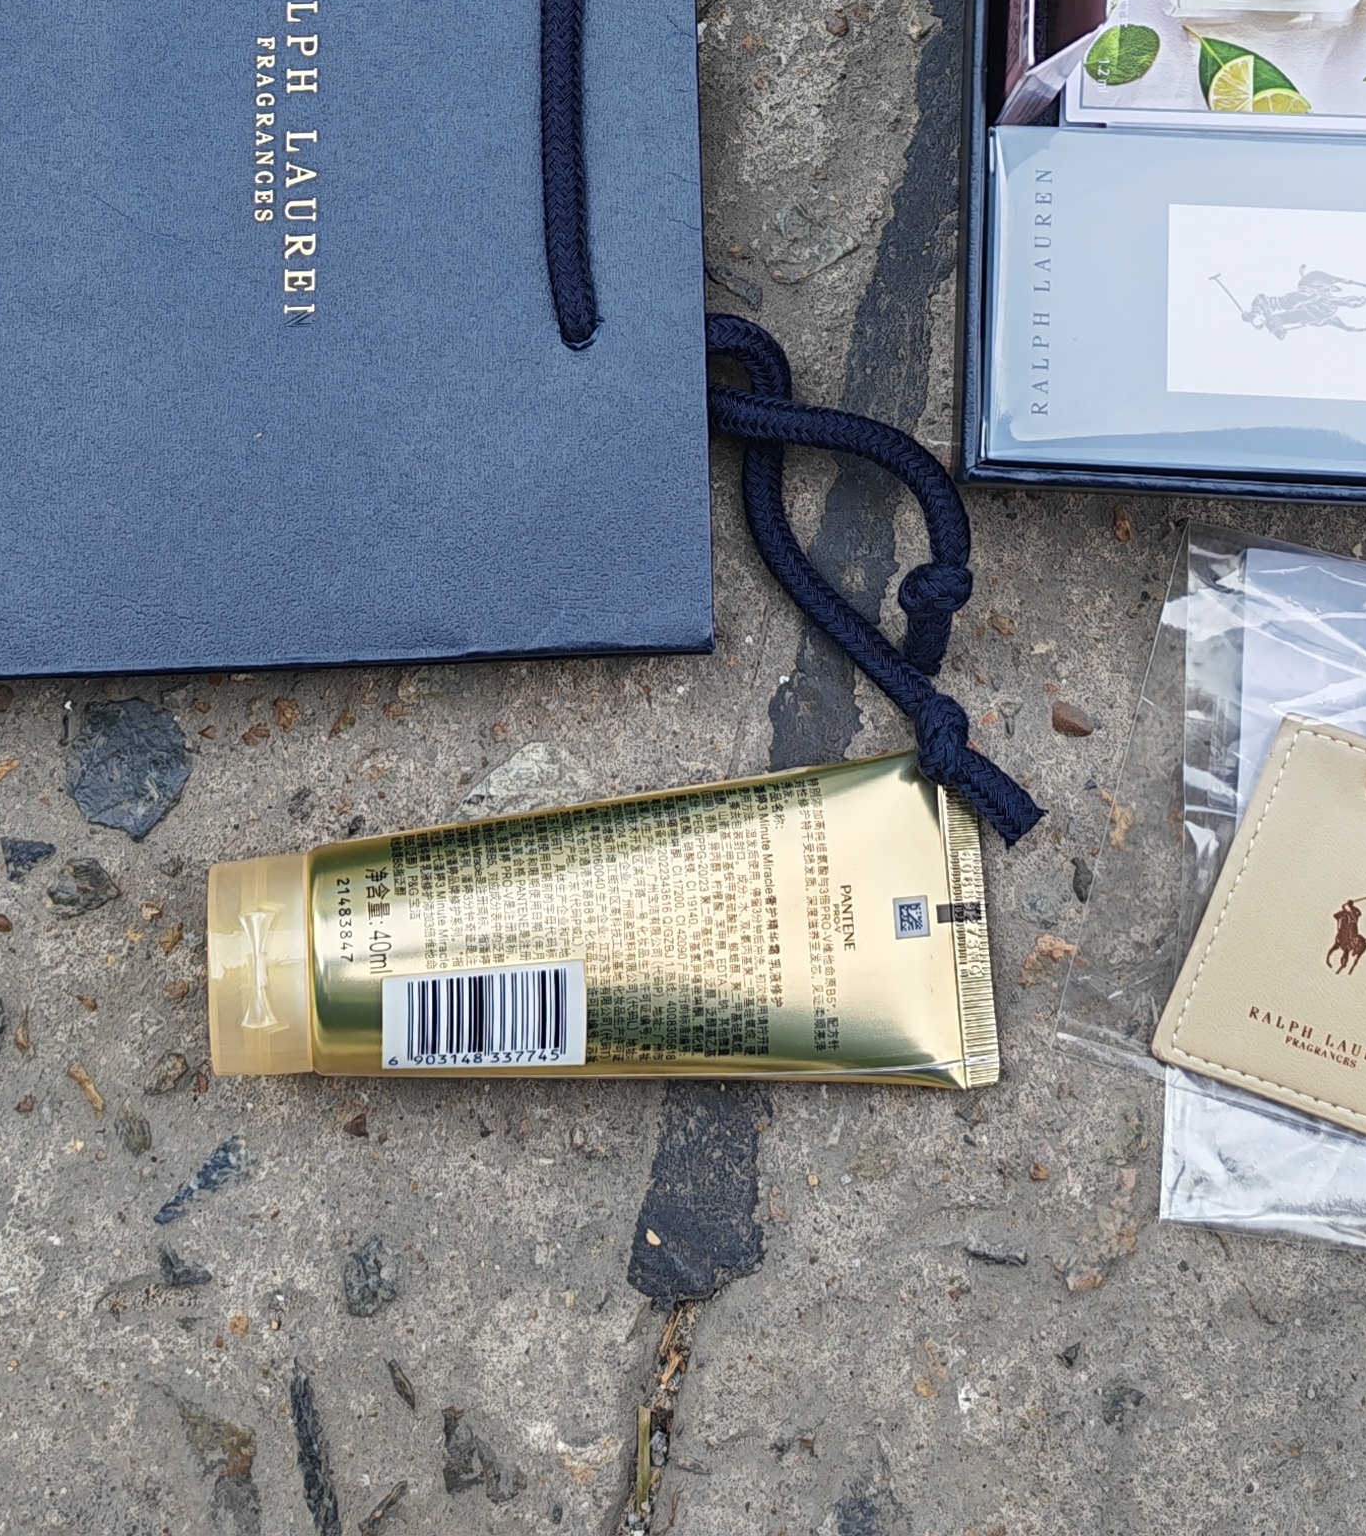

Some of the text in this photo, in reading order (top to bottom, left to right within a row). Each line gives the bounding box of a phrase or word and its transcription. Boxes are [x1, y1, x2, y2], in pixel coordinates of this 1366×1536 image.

[254, 37, 276, 224] FRAGRANCES
[283, 130, 320, 328] LAUREN
[1031, 169, 1053, 416] RALPH LAUREN
[511, 857, 524, 877] 合格
[336, 877, 353, 963] 21483847
[363, 865, 393, 975] 净含量：40ml
[406, 874, 422, 921] P&G 宝洁
[675, 914, 686, 926] CI
[757, 812, 771, 853] Minute
[768, 958, 784, 1007] 乳液修护
[838, 884, 856, 951] PANTENE
[433, 890, 451, 969] Minute Miracle
[660, 915, 676, 959] Q/GZBJ
[675, 928, 688, 960] 42090
[1249, 1006, 1314, 1039] RALPH
[388, 1049, 560, 1066] 6 903148 337745
[1285, 1035, 1358, 1069] FRAGRANCES
